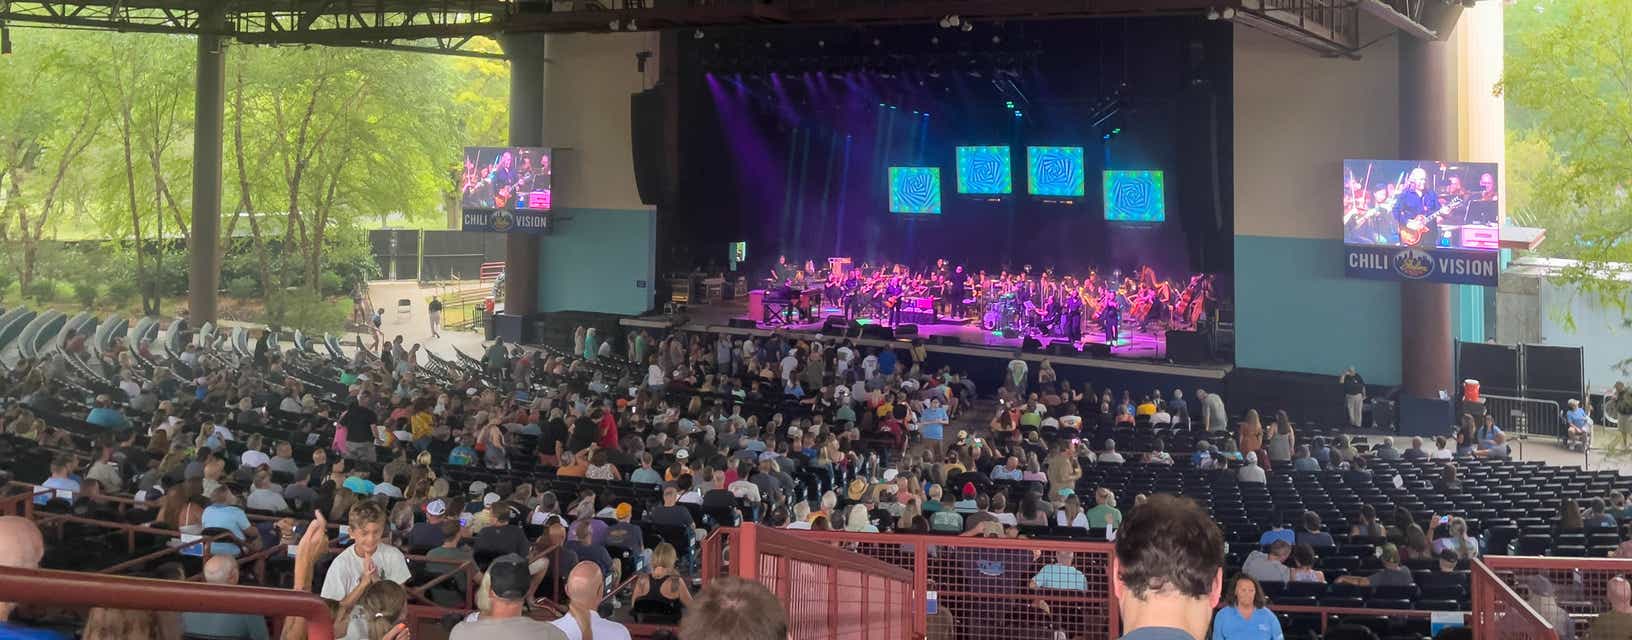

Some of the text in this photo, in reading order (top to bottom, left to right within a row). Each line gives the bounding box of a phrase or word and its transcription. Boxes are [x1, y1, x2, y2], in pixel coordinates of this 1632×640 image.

[464, 214, 487, 225] CHILI
[516, 215, 547, 227] VISION
[1349, 252, 1388, 269] CHILI
[1439, 258, 1493, 276] VISION
